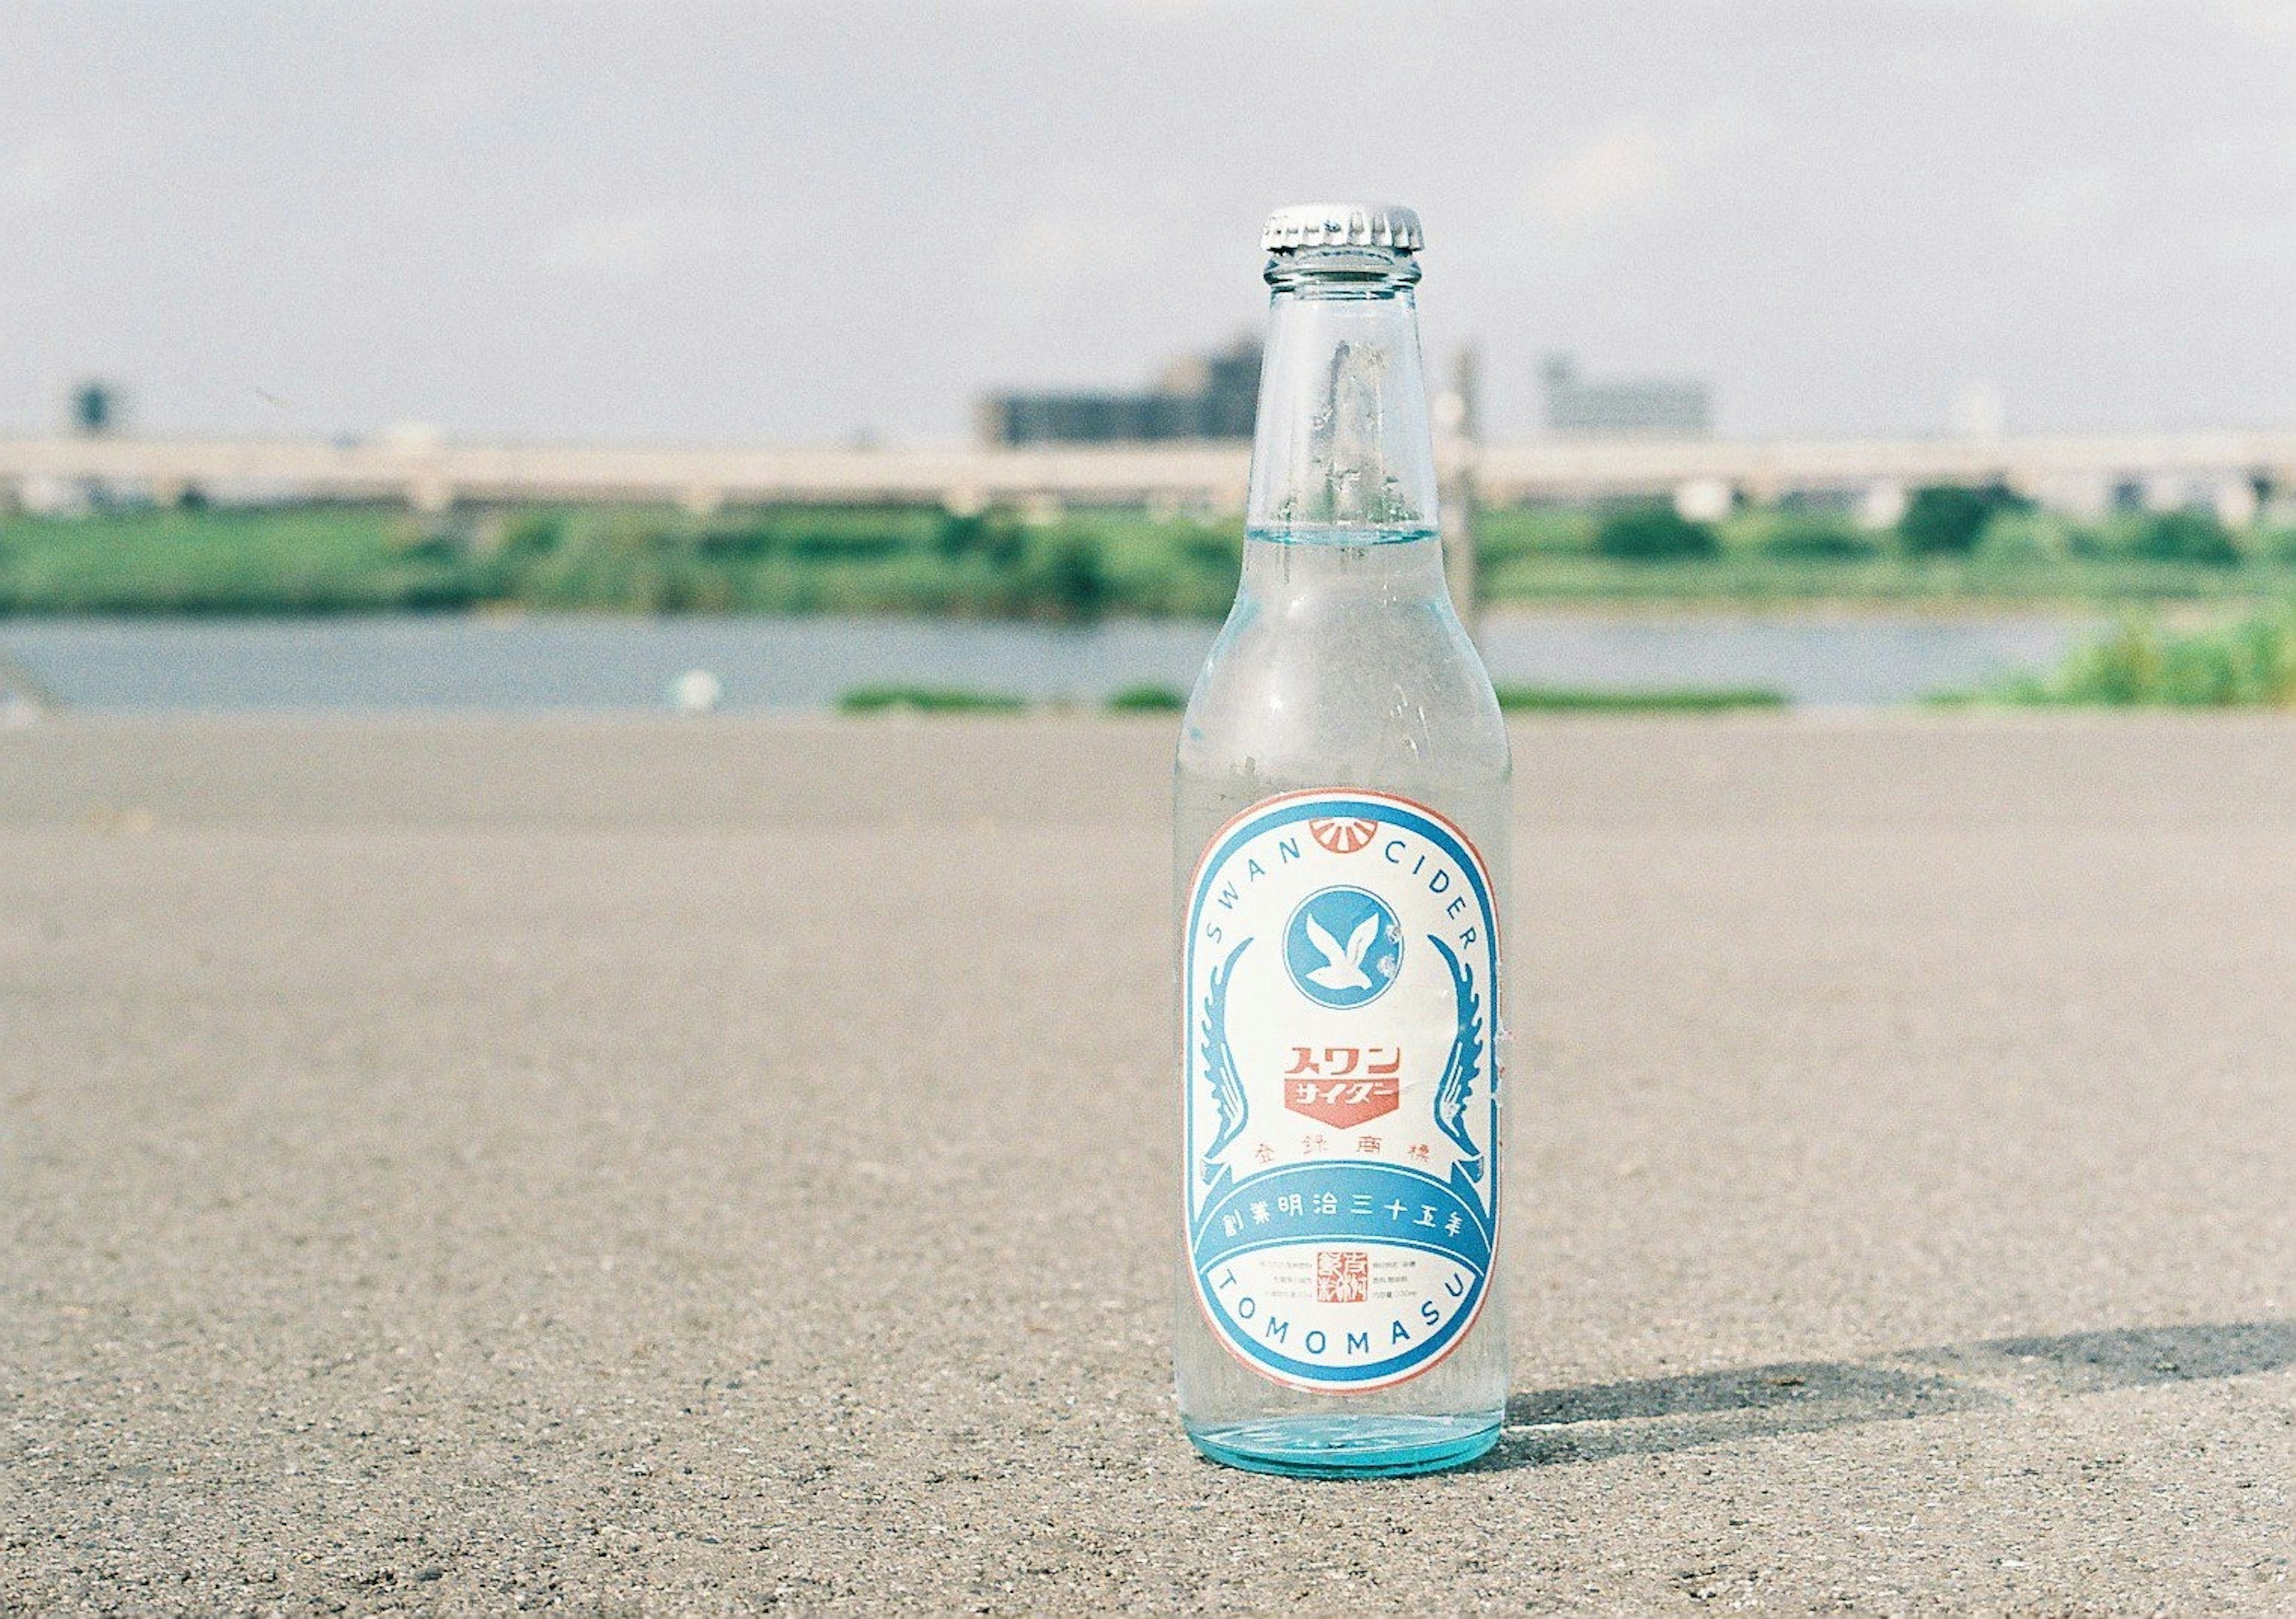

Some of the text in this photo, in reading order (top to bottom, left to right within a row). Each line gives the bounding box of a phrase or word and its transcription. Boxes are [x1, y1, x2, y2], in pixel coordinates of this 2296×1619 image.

[1207, 838, 1477, 949] SWAN CIDER
[1285, 1047, 1400, 1074] スワン
[1296, 1082, 1395, 1105] サイダー
[1222, 1192, 1463, 1238] 創業明治三十五年
[1220, 1268, 1465, 1355] TOMOMASU
